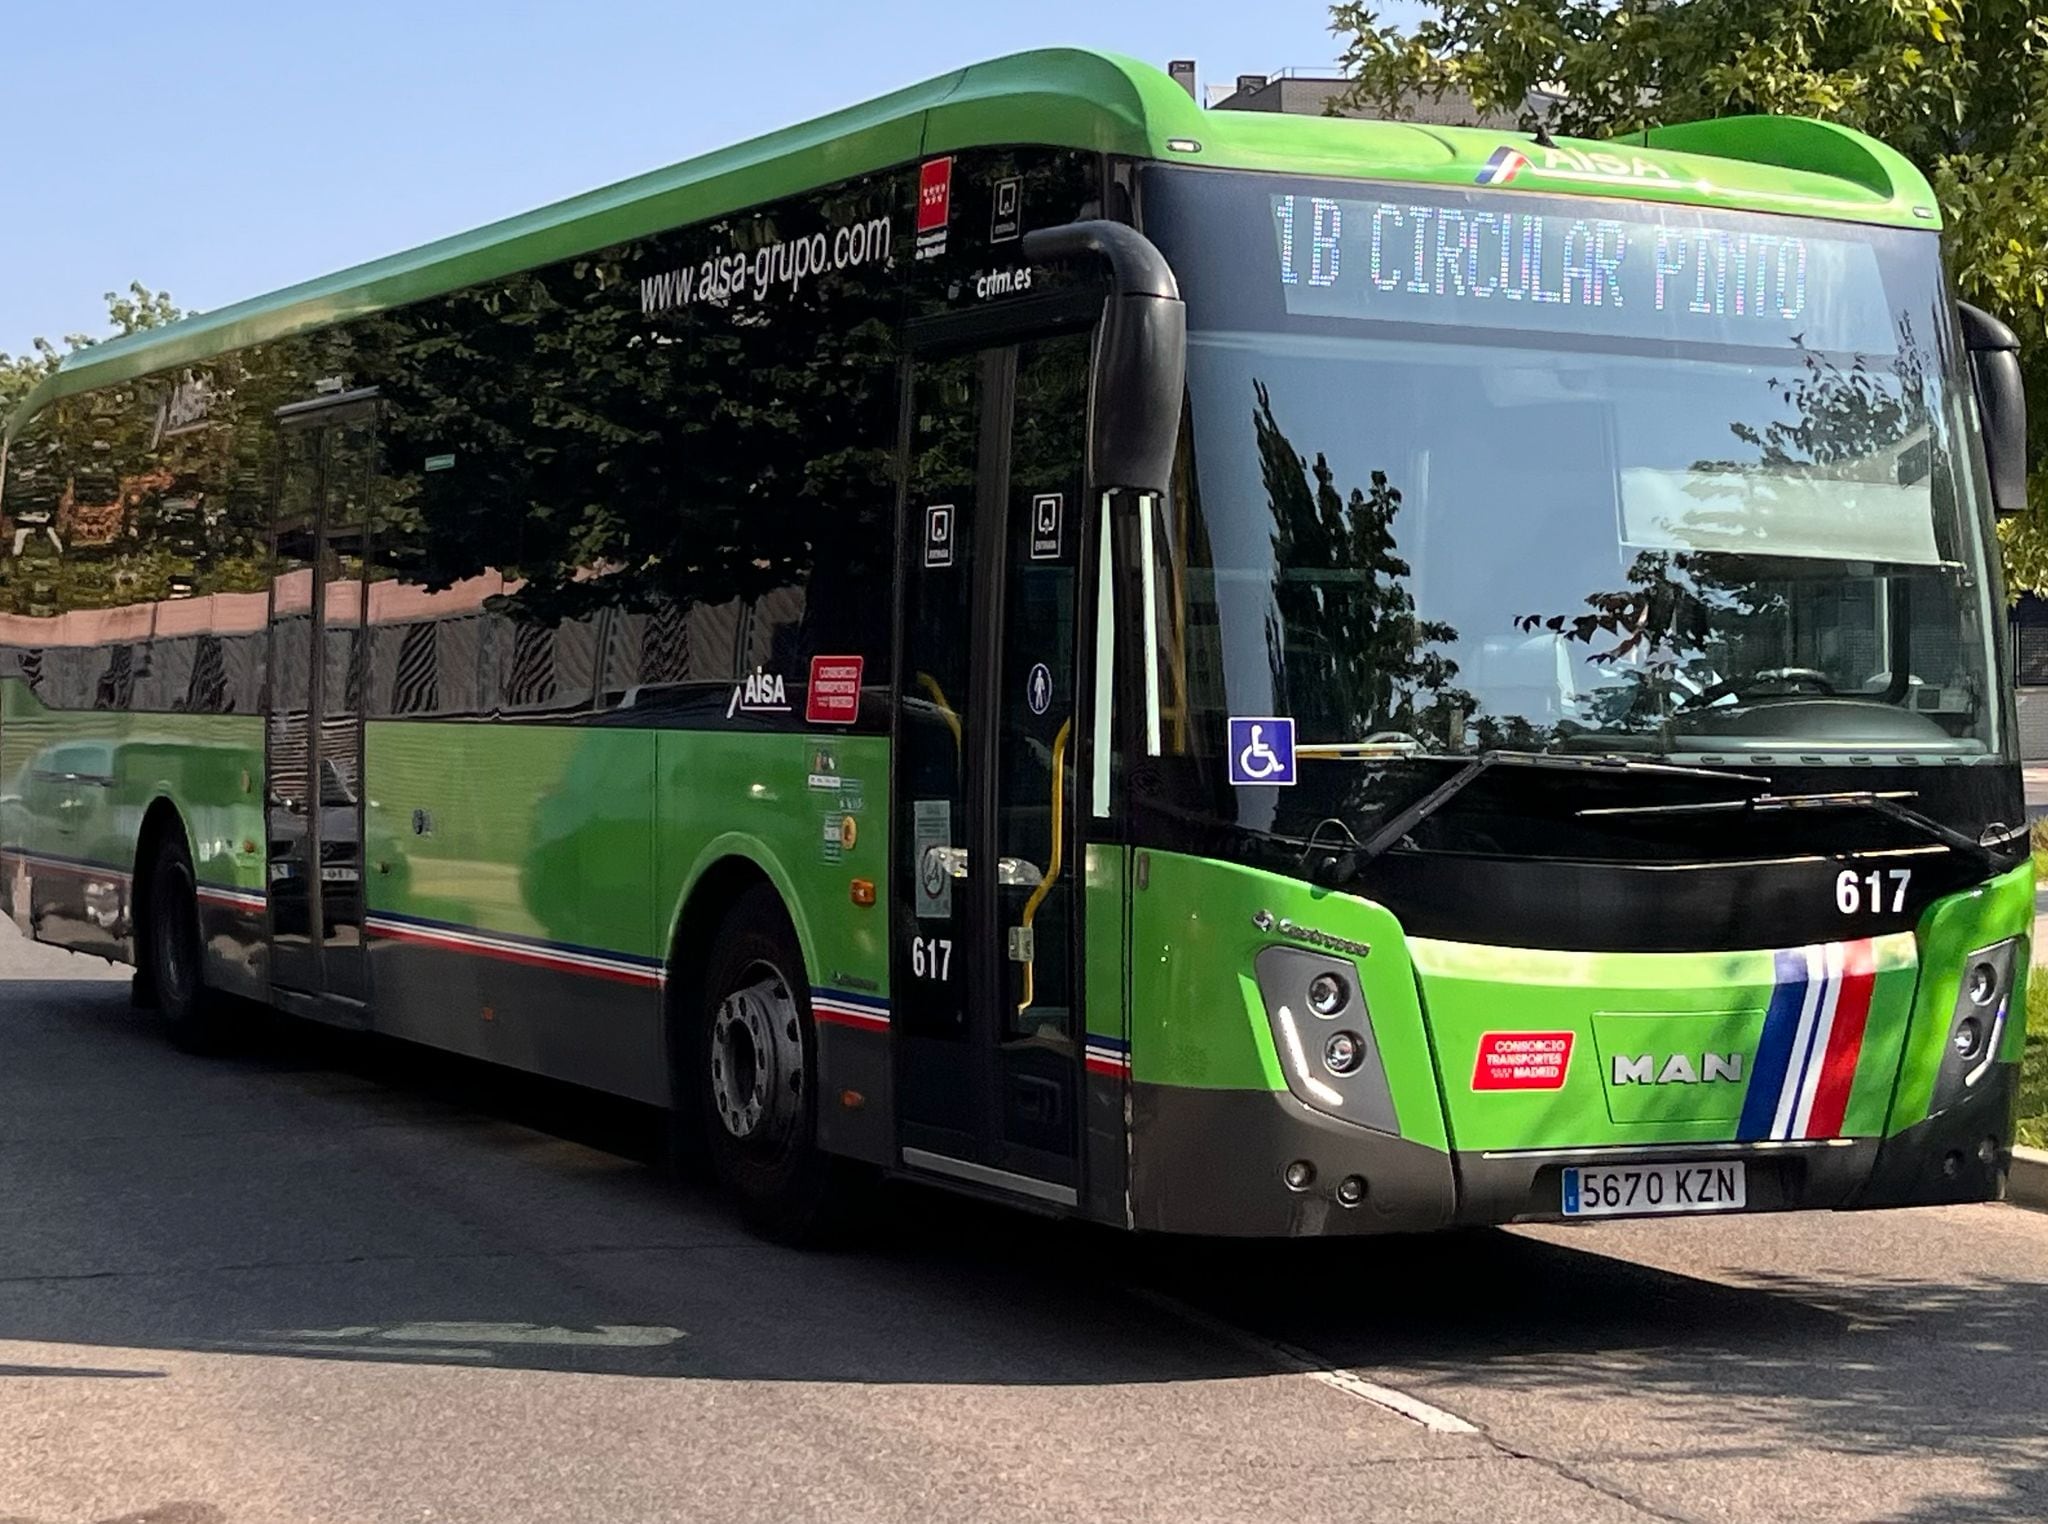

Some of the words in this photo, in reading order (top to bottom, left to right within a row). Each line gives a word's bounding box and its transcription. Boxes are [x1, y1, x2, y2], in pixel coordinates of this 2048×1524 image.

[640, 216, 891, 314] www.aisa-grupo.com
[1277, 195, 1342, 287] 1B
[1371, 203, 1624, 307] CIRCULAR
[1654, 224, 1807, 320] PINTO
[1835, 869, 1912, 914] 617
[912, 936, 952, 981] 617
[1486, 1053, 1562, 1065] TRANSPORTES
[1494, 1039, 1566, 1053] CONSORCIO
[1513, 1066, 1559, 1079] MADRID
[1612, 1052, 1743, 1086] MAN
[1583, 1171, 1664, 1208] 5670
[1675, 1168, 1735, 1203] KZN
